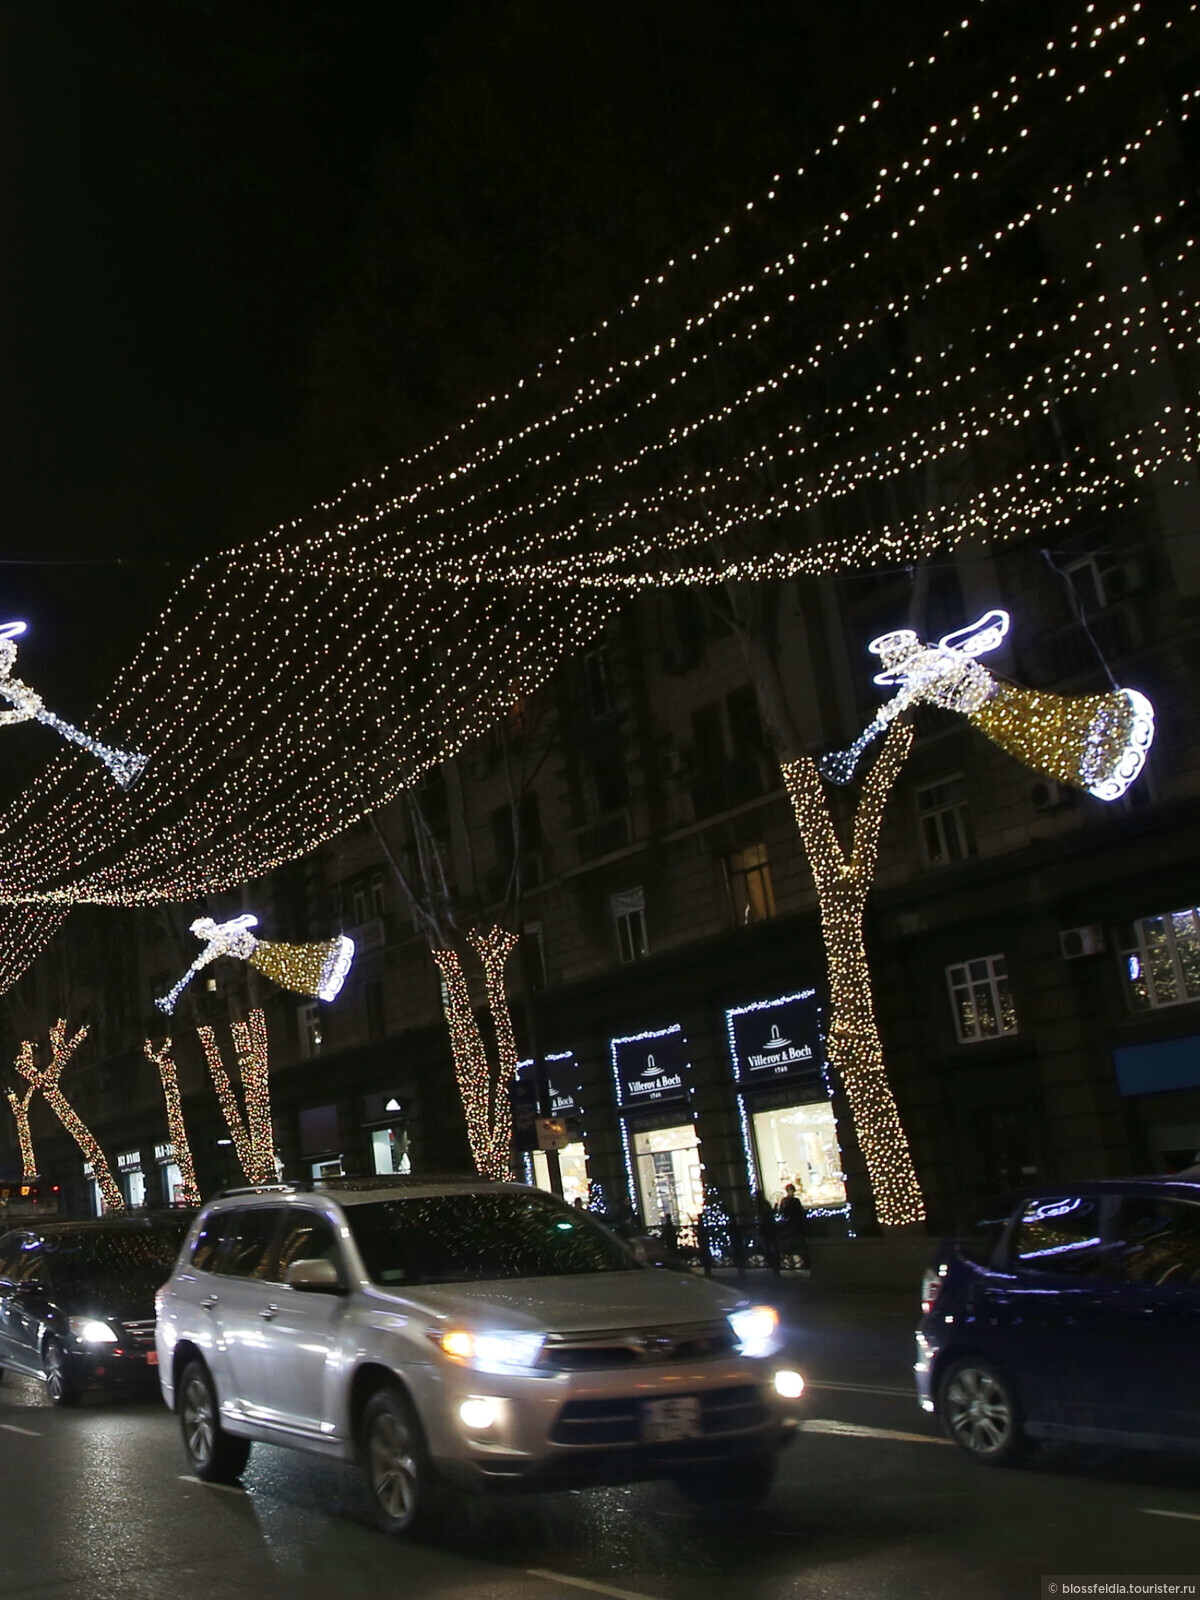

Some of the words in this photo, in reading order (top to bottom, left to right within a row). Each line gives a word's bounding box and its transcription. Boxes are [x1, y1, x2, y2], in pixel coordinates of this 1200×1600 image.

[747, 1053, 781, 1067] Villeroy
[788, 1044, 812, 1059] Boch
[627, 1080, 655, 1092] Villeroy
[662, 1073, 681, 1086] Boch
